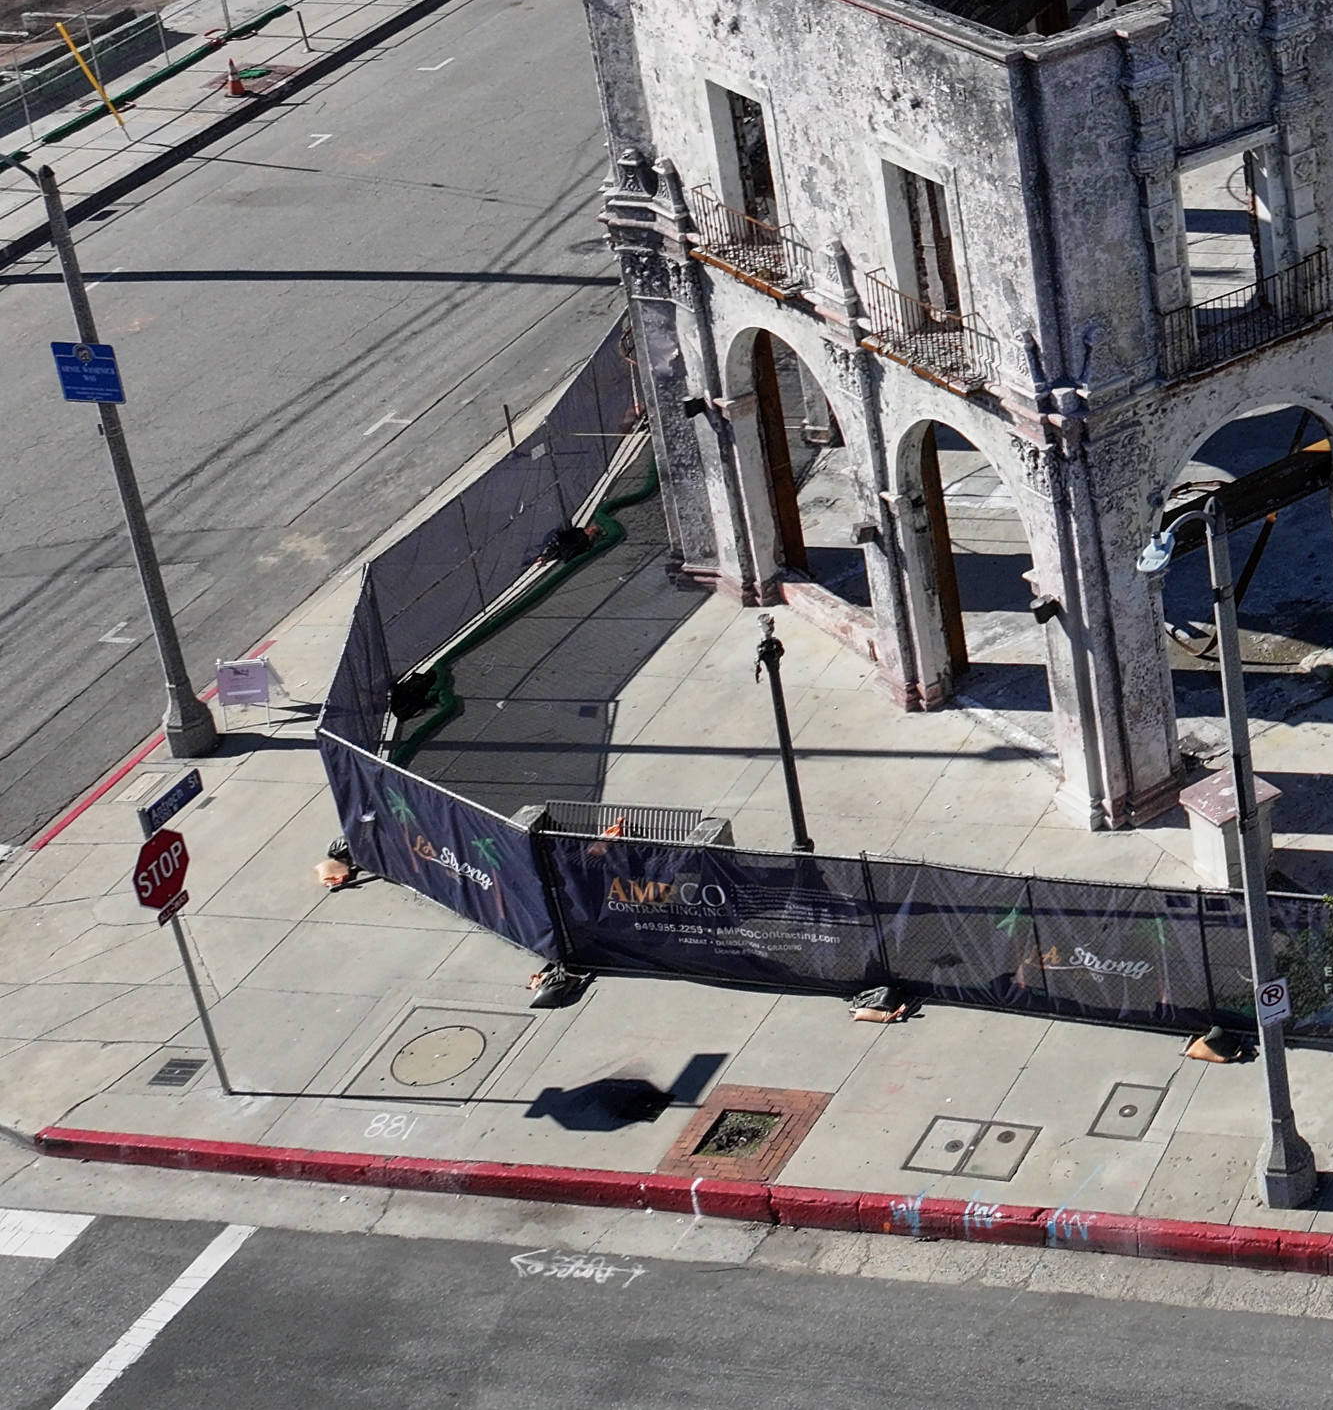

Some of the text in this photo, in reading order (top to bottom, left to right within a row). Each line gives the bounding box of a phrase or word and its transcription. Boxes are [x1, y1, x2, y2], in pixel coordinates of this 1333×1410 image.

[138, 840, 183, 899] STOP
[440, 846, 494, 891] Strong
[607, 876, 726, 908] AMPCO
[1068, 946, 1154, 980] Strong
